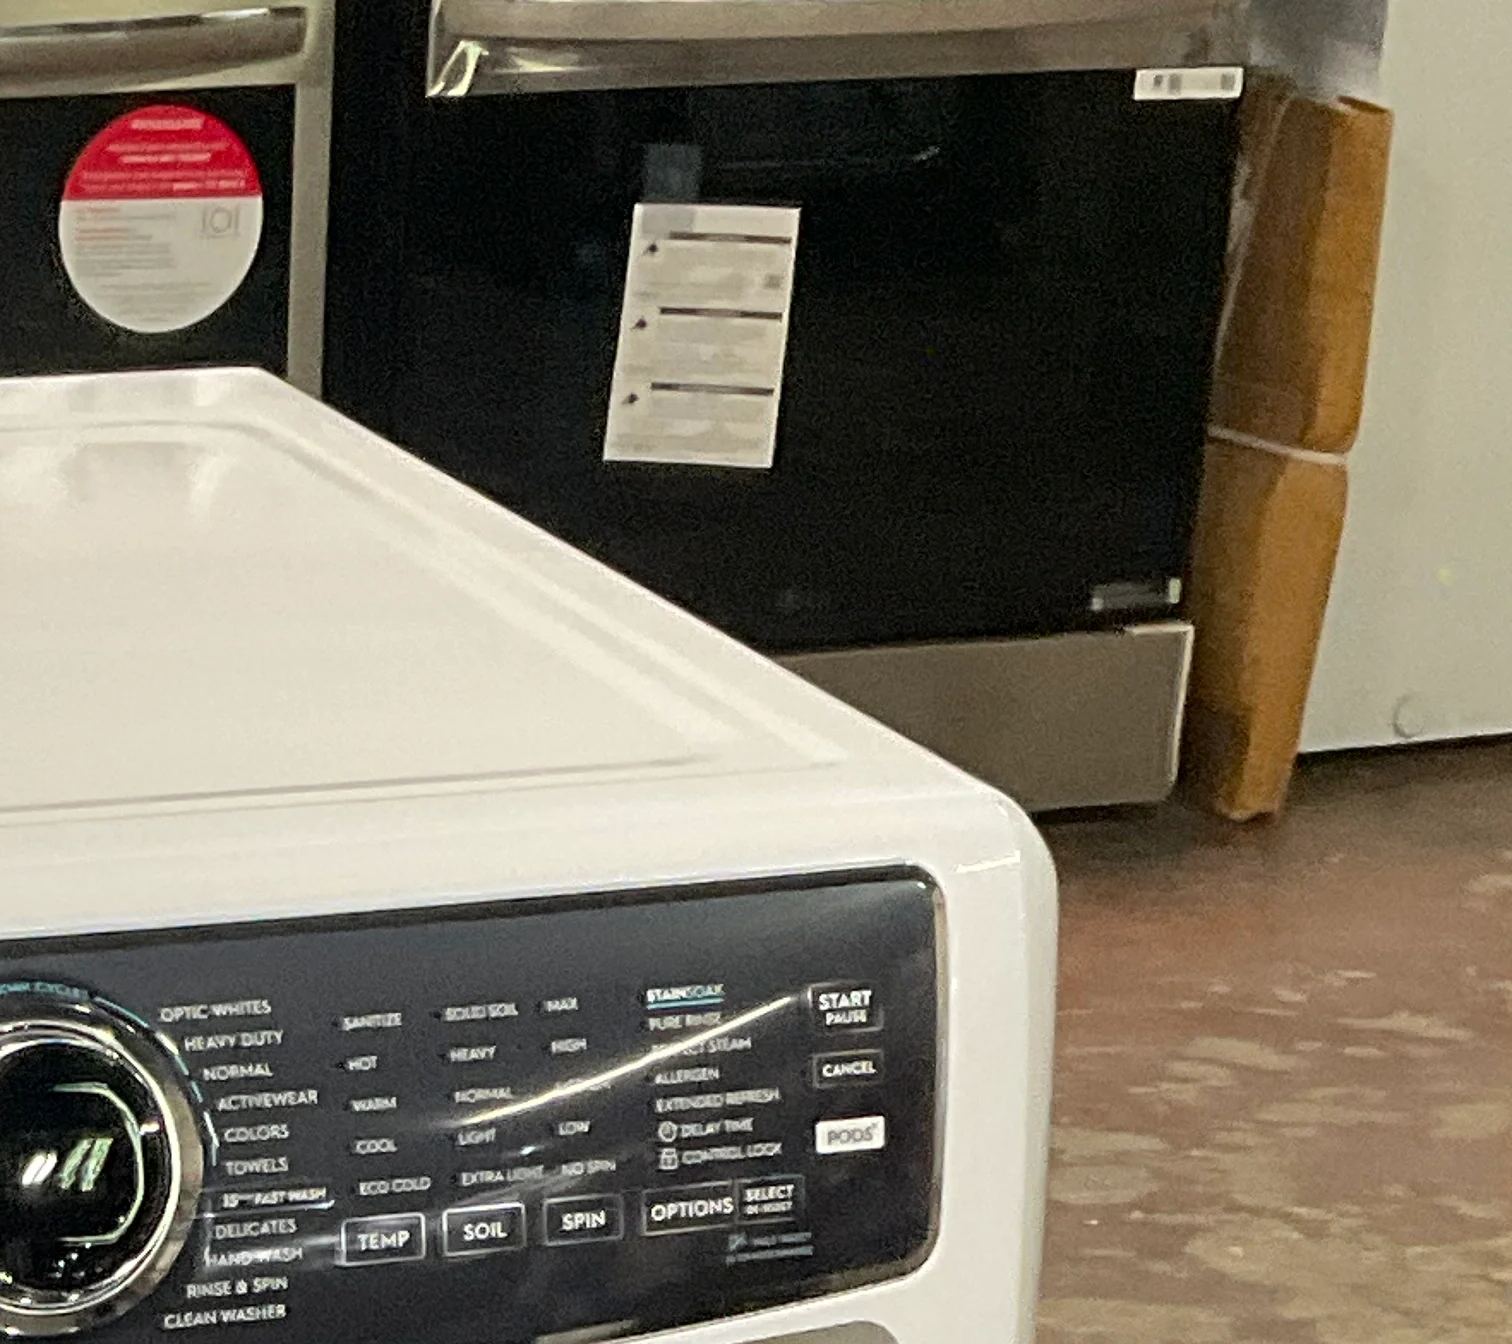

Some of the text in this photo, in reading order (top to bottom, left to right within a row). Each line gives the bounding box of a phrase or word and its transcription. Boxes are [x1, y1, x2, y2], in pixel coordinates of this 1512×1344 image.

[818, 990, 872, 1010] START
[160, 1000, 272, 1022] OPTIC WHITES
[184, 1029, 284, 1052] HEAVY DUTY
[203, 1063, 273, 1081] NORMAL
[822, 1060, 876, 1078] CANCEL
[218, 1089, 318, 1111] ACTIVEWEAR
[224, 1124, 289, 1143] COLORS
[225, 1157, 288, 1176] TOWELS
[462, 1171, 505, 1187] EXTRA
[651, 1196, 735, 1222] OPTIONS
[215, 1217, 298, 1240] DELICATES
[561, 1209, 607, 1232] SPIN
[357, 1230, 411, 1250] TEMP
[463, 1221, 509, 1242] SOIL
[186, 1274, 289, 1299] RINSE & SPIN
[163, 1303, 287, 1330] CLEAN WASHER
